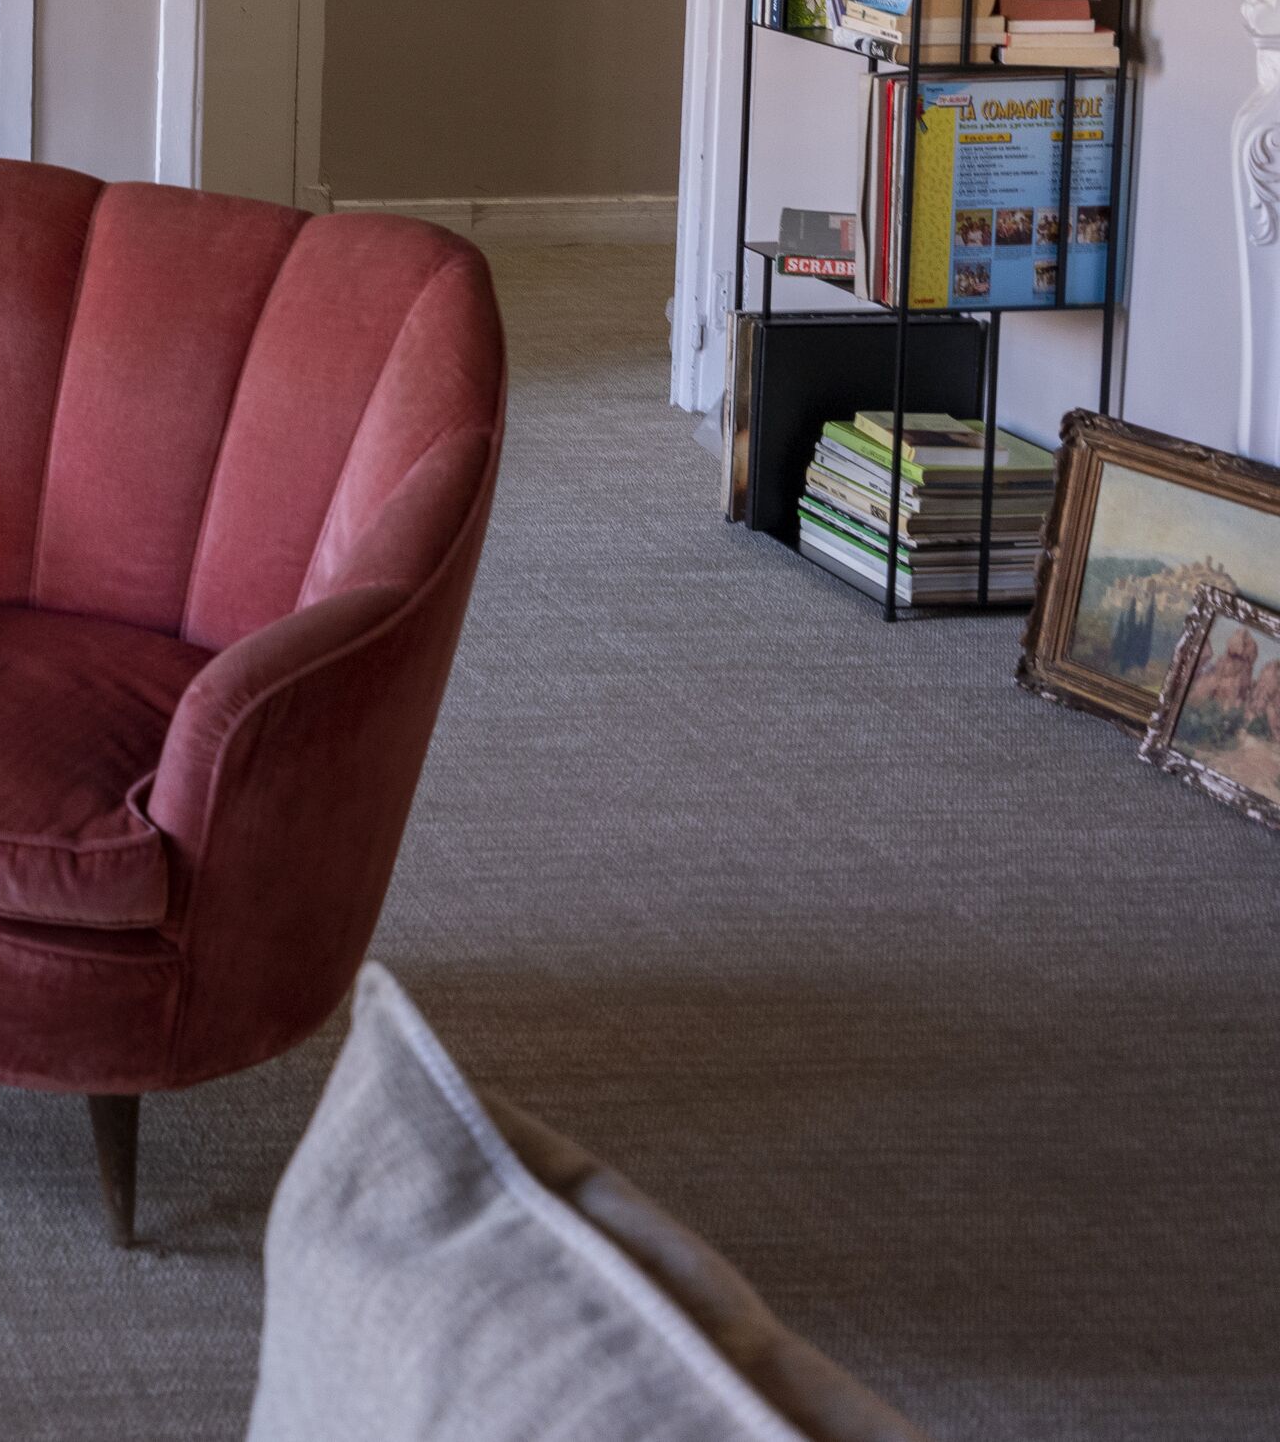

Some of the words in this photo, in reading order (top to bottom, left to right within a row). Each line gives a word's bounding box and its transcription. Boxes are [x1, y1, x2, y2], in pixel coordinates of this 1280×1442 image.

[959, 98, 977, 122] LA
[982, 98, 1055, 121] COMPAGNIE
[1058, 96, 1104, 119] CEOLE
